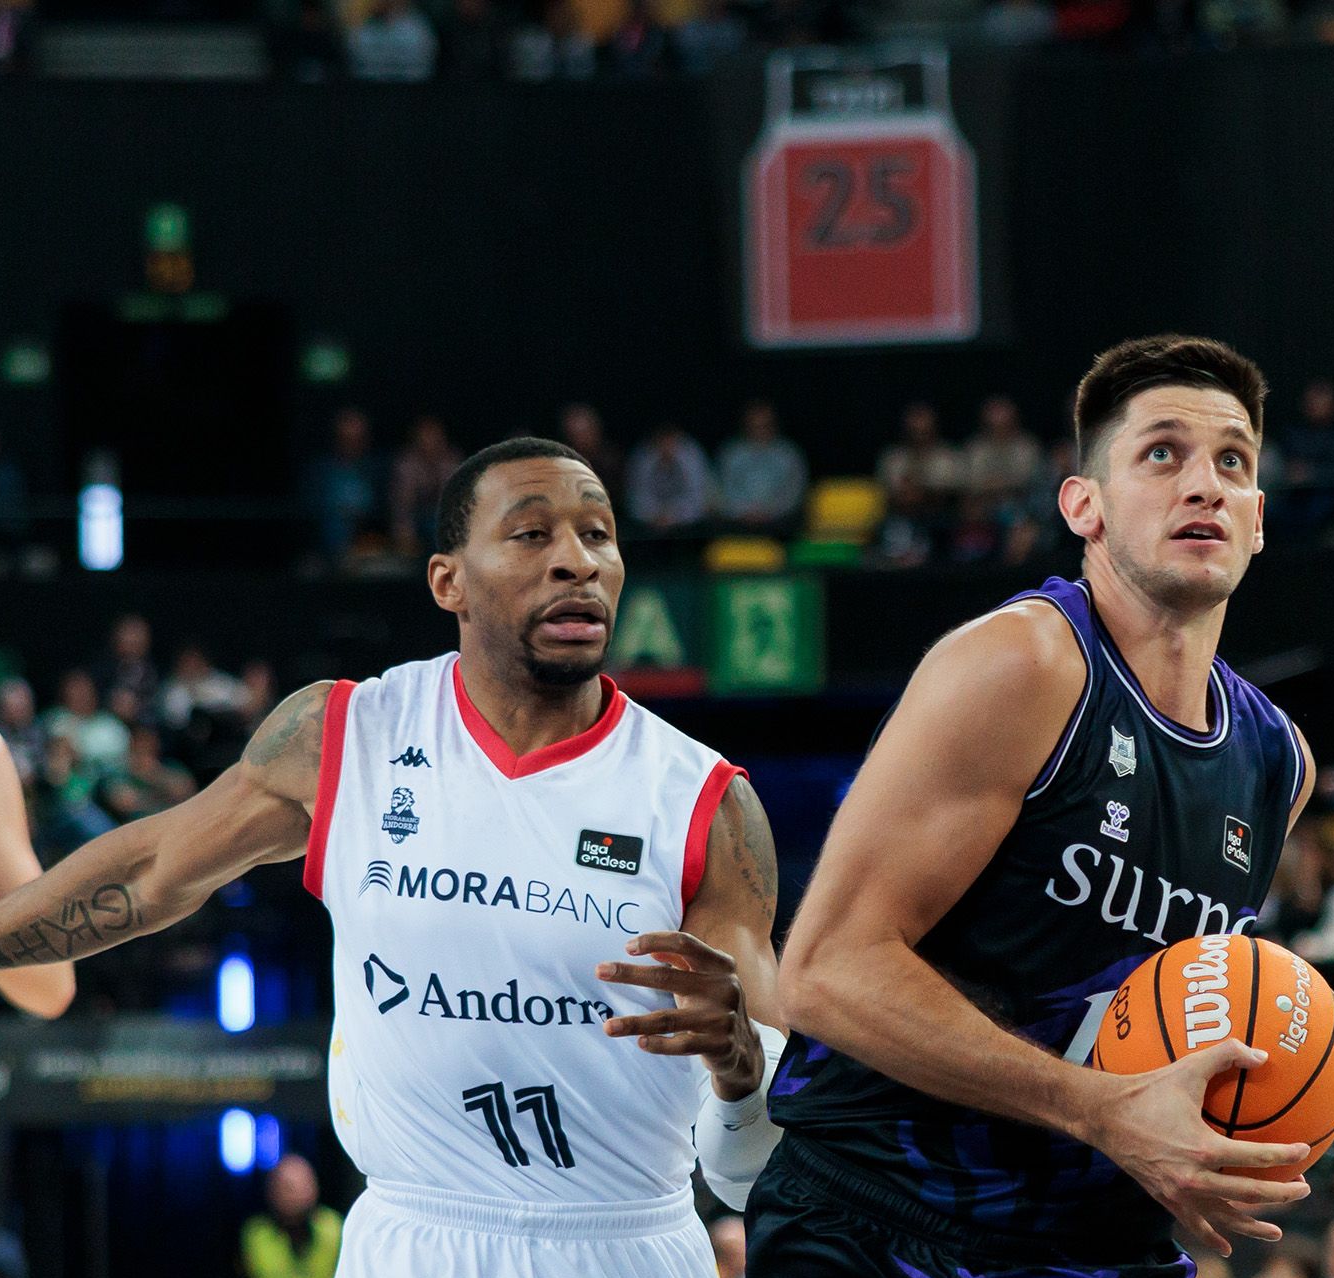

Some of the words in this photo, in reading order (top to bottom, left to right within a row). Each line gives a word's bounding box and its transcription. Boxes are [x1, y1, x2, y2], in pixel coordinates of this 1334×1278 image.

[804, 155, 915, 247] 25
[581, 853, 636, 871] endesa
[582, 840, 609, 855] liga
[397, 865, 640, 935] MORABANC
[1112, 984, 1131, 1040] acb
[1277, 1005, 1308, 1054] liga
[462, 1081, 575, 1168] 11
